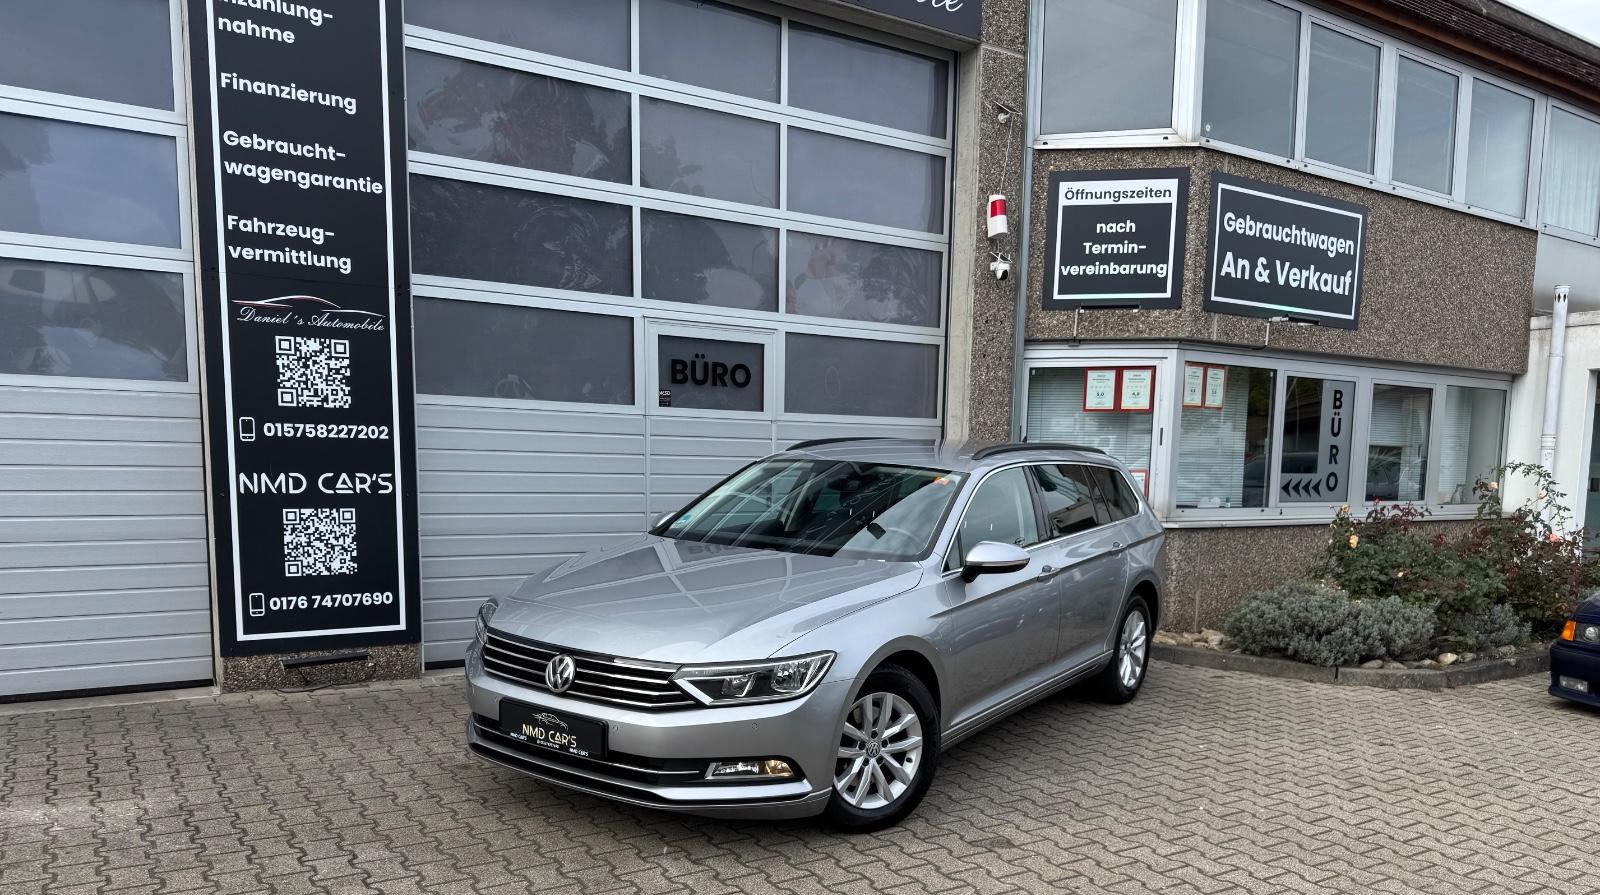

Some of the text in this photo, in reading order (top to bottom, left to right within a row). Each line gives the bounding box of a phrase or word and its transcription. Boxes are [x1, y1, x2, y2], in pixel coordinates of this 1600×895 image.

[218, 17, 295, 44] nahme
[220, 72, 357, 115] Finanzierung
[223, 130, 346, 161] Gebraucht-
[224, 159, 383, 194] wagengarantie
[1064, 186, 1172, 203] Öffnungszeiten
[227, 215, 335, 245] Fahrzeug-
[1096, 220, 1136, 234] nach
[1223, 211, 1354, 258] Gebrauchtwagen
[228, 243, 352, 275] vermittlung
[1083, 240, 1147, 255] Termin-
[1061, 261, 1167, 278] vereinbarung
[1220, 251, 1352, 296] An & Verkauf
[308, 312, 385, 331] Automobile
[671, 353, 751, 388] BÜRO
[263, 422, 389, 440] 015758227202
[1326, 389, 1343, 492] BÜRO
[239, 472, 393, 495] NMD CAR'S
[269, 591, 393, 611] 0176 74707690
[522, 723, 546, 740] NMD
[548, 730, 577, 748] CAR'S
